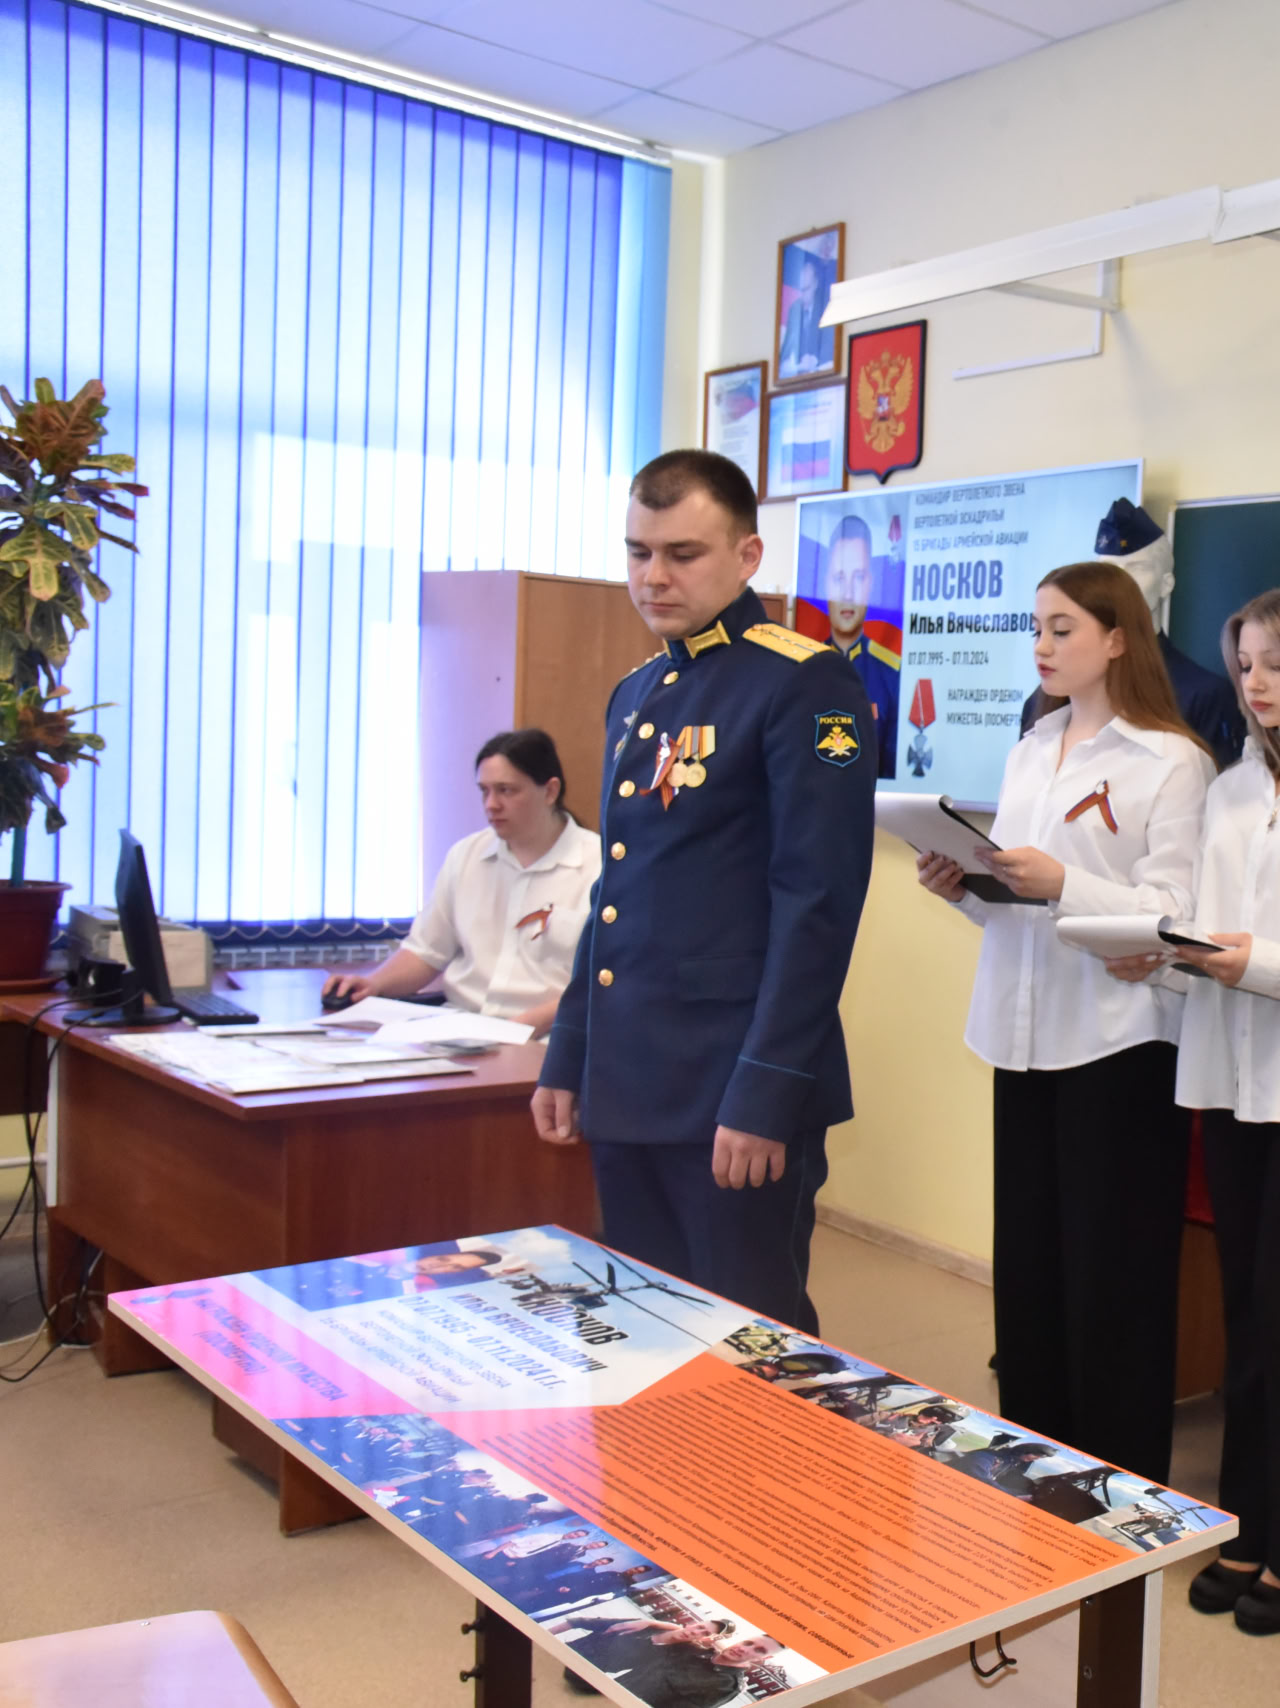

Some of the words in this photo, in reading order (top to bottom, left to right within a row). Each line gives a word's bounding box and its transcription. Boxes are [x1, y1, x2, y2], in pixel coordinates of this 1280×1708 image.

[915, 491, 950, 505] КОМАНДИР
[914, 510, 958, 529] ВЕРТОЛЕТНОЙ
[912, 560, 1003, 601] НОСКОВ
[909, 613, 944, 634] Илья
[947, 612, 1035, 634] Вячеславов
[908, 652, 943, 665] 07.07.1995
[952, 651, 988, 665] 07.11.2024
[393, 1295, 479, 1334] 07.07.1995
[463, 1334, 556, 1377] 07.11.2024
[444, 1292, 500, 1314] ИЛЬЯ
[480, 1312, 610, 1373] ВЯЧЕСЛАВОВИЧ
[515, 1297, 633, 1346] НОСКОВ
